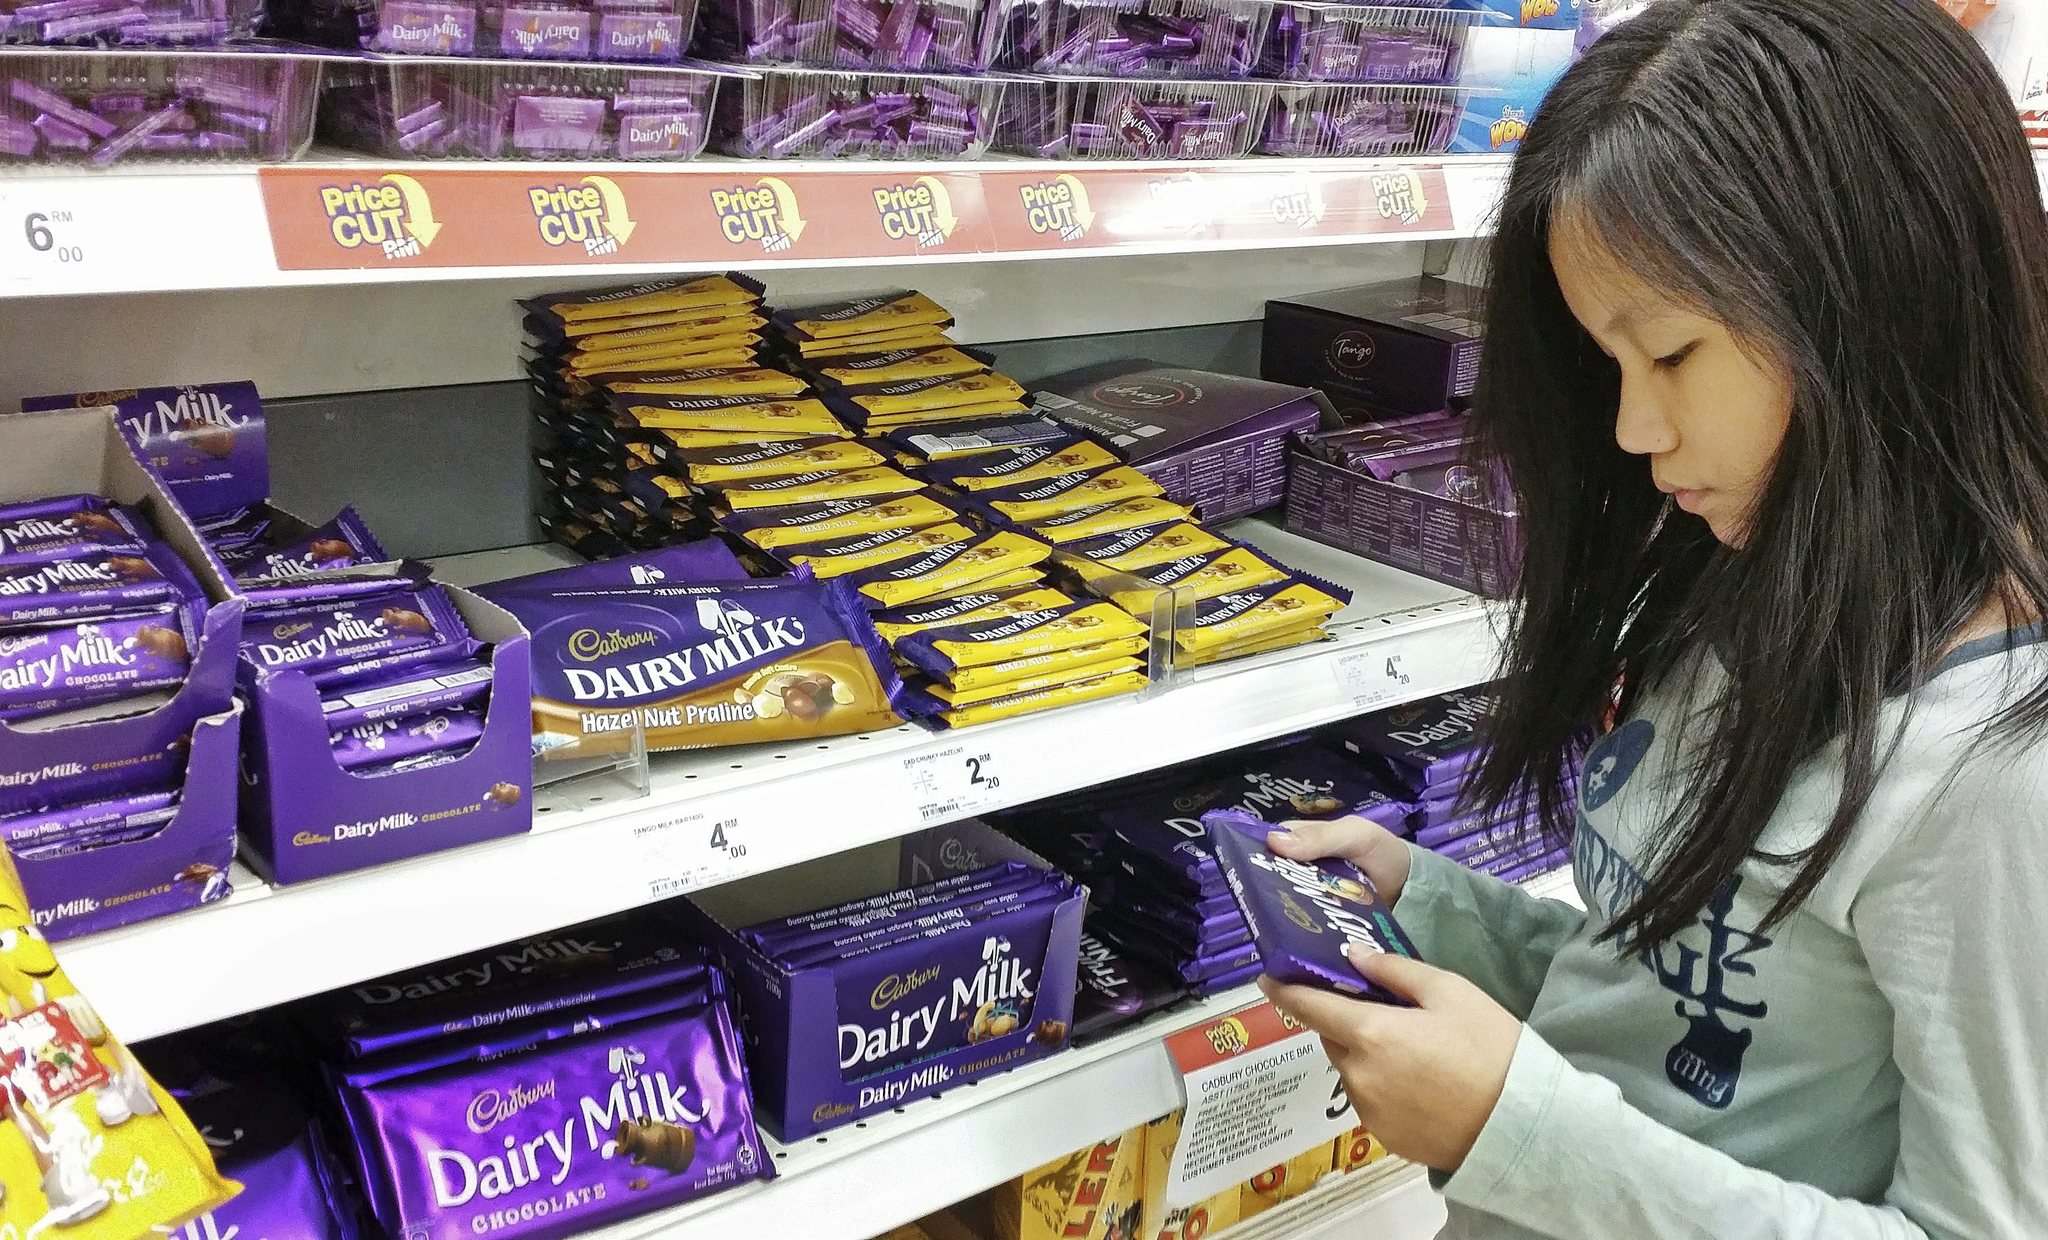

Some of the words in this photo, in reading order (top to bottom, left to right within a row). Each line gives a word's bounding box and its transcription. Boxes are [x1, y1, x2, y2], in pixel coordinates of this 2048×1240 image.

[392, 24, 430, 41] Dairy
[432, 21, 464, 39] Milk
[519, 27, 545, 45] Milk
[545, 25, 579, 42] Dairy
[612, 31, 644, 48] Dairy
[646, 26, 672, 46] Milk
[630, 127, 662, 144] Dairy
[664, 120, 690, 140] Milk
[1136, 119, 1156, 144] Dairy
[320, 184, 401, 216] Price
[528, 185, 600, 216] Price
[711, 185, 775, 216] Price
[873, 185, 931, 213] Price
[1020, 183, 1070, 209] Price
[1371, 175, 1410, 199] Price
[1028, 203, 1074, 234] CUT
[1271, 194, 1310, 224] CUT
[1376, 193, 1414, 218] CUT
[24, 212, 54, 252] 6
[51, 210, 73, 223] RM
[332, 210, 405, 248] CUT
[539, 211, 605, 245] CUT
[721, 208, 780, 243] CUT
[882, 205, 934, 240] CUT
[58, 246, 83, 263] 00
[587, 287, 633, 304] DAIRY
[632, 279, 677, 297] MILK
[821, 306, 857, 322] DAIRY
[853, 297, 884, 315] MILK
[850, 356, 887, 371] DAIRY
[884, 348, 917, 364] MILK
[1336, 339, 1372, 361] Tango
[640, 374, 687, 384] DAIRY
[881, 379, 920, 396] DAIRY
[917, 373, 951, 389] MILK
[155, 392, 243, 442] Milk
[669, 399, 722, 411] DAIRY
[714, 450, 764, 466] DAIRY
[762, 441, 804, 459] MILK
[982, 456, 1023, 476] DAIRY
[1021, 445, 1052, 468] MILK
[751, 476, 800, 491] DAIRY
[797, 467, 840, 487] MILK
[1018, 482, 1059, 501] DAIRY
[1056, 470, 1090, 492] MILK
[780, 509, 832, 526] DAIRY
[829, 499, 872, 520] MILK
[1045, 508, 1086, 527] DAIRY
[3, 519, 74, 544] Milk
[824, 537, 874, 555] DAIRY
[871, 526, 914, 546] MILK
[1084, 539, 1124, 560] DAIRY
[1120, 526, 1155, 551] MILK
[889, 558, 937, 579] DAIRY
[931, 541, 968, 563] MILK
[1176, 552, 1208, 577] MILK
[0, 570, 49, 596] airy
[42, 560, 112, 586] Milk
[686, 585, 721, 595] DAIRY
[12, 609, 38, 621] Dairy
[38, 607, 60, 618] Milk
[905, 603, 958, 624] DAIRY
[955, 592, 1000, 615] MILK
[1195, 608, 1232, 627] DAIRY
[1229, 591, 1264, 615] MILK
[969, 619, 1023, 642] DAIRY
[1018, 606, 1060, 631] MILK
[258, 633, 327, 666] Dairy
[324, 619, 387, 647] Milk
[335, 639, 393, 657] CHOCOLATE
[568, 627, 657, 663] Cadbury
[0, 652, 58, 691] airy
[58, 636, 138, 675] Milk
[563, 650, 697, 702] DAIRY
[695, 614, 807, 676] MILK
[1385, 657, 1399, 680] 4
[64, 668, 139, 687] CHOCOLATE
[1398, 673, 1411, 685] 20
[581, 709, 640, 735] Hazel
[643, 706, 683, 729] Nut
[686, 700, 756, 727] Praline
[1386, 714, 1474, 747] Dairy
[41, 761, 85, 780] Milk
[91, 752, 164, 773] CHOCOLATE
[965, 757, 985, 785] 2
[978, 752, 992, 764] RM
[12, 826, 41, 842] Dairy
[38, 820, 64, 835] Milk
[334, 820, 379, 841] Dairy
[378, 811, 417, 831] Milk
[421, 802, 482, 824] CHOCOLATE
[633, 824, 657, 836] TANGO
[657, 820, 673, 831] MILK
[710, 822, 729, 852] 4
[724, 818, 739, 830] RM
[293, 830, 333, 848] Cadbury
[103, 883, 172, 909] CHOCOLATE
[888, 887, 915, 904] Dairy
[55, 898, 98, 921] Milk
[938, 906, 964, 921] Dairy
[349, 960, 494, 1006] Dairy
[495, 938, 602, 974] Milk
[870, 964, 941, 1011] Cadbury
[472, 1010, 507, 1030] Dairy
[505, 1003, 533, 1021] Milk
[536, 1001, 554, 1014] milk
[555, 991, 597, 1010] chocolate
[838, 994, 947, 1070] Dairy
[949, 956, 1035, 1022] Milk
[1205, 1022, 1234, 1043] Price
[1213, 1032, 1240, 1055] CUT
[858, 1077, 911, 1110] Dairy
[910, 1063, 951, 1092] Milk
[958, 1046, 1027, 1076] CHOCOLATE
[1201, 1066, 1243, 1093] CADBURY
[1244, 1050, 1296, 1078] CHOCOLATE
[1297, 1043, 1314, 1057] BAR
[466, 1077, 557, 1134] Cadbury
[1201, 1089, 1225, 1107] ASST
[425, 1116, 575, 1208] Dairy
[579, 1070, 702, 1153] Milk
[1186, 1141, 1216, 1160] WORTH
[1245, 1118, 1274, 1137] SINGLE
[1192, 1125, 1212, 1139] WITH
[1218, 1131, 1268, 1157] REDEMPTION
[1266, 1125, 1279, 1138] AT
[1182, 1158, 1226, 1183] CUSTOMER
[1226, 1144, 1259, 1162] SERVICE
[1259, 1127, 1294, 1150] COUNTER
[471, 1183, 608, 1235] CHOCOLATE
